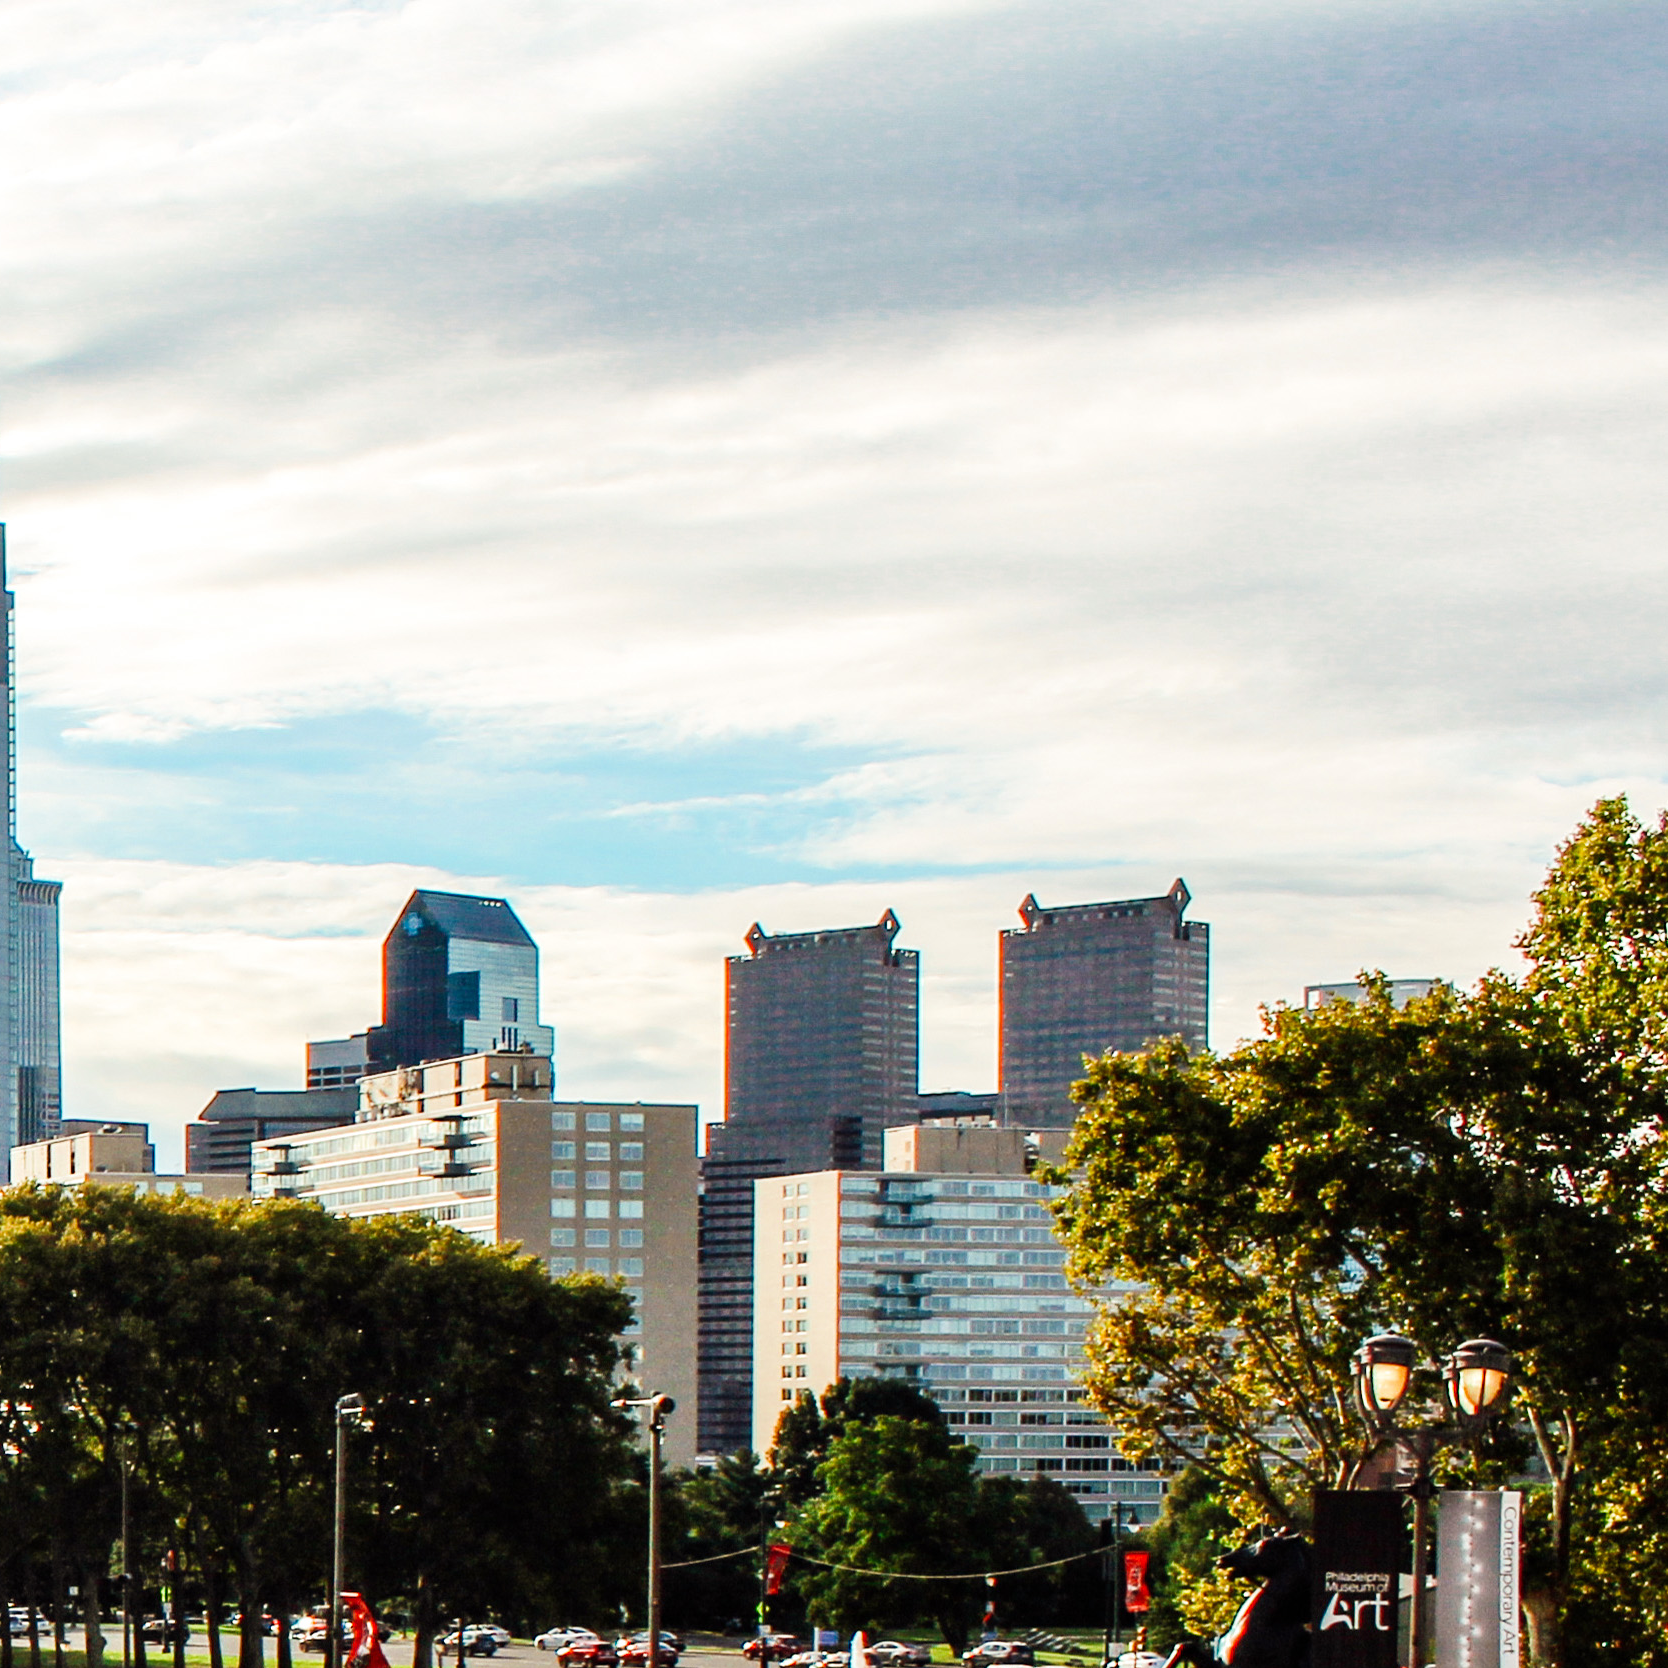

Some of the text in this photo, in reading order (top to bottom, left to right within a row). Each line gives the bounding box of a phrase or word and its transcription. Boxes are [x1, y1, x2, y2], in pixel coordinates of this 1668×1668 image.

[1325, 1571, 1390, 1583] Philadelphia
[1325, 1582, 1389, 1592] Museum of
[1500, 1506, 1517, 1654] Contemporary Art
[1320, 1592, 1389, 1631] Art
